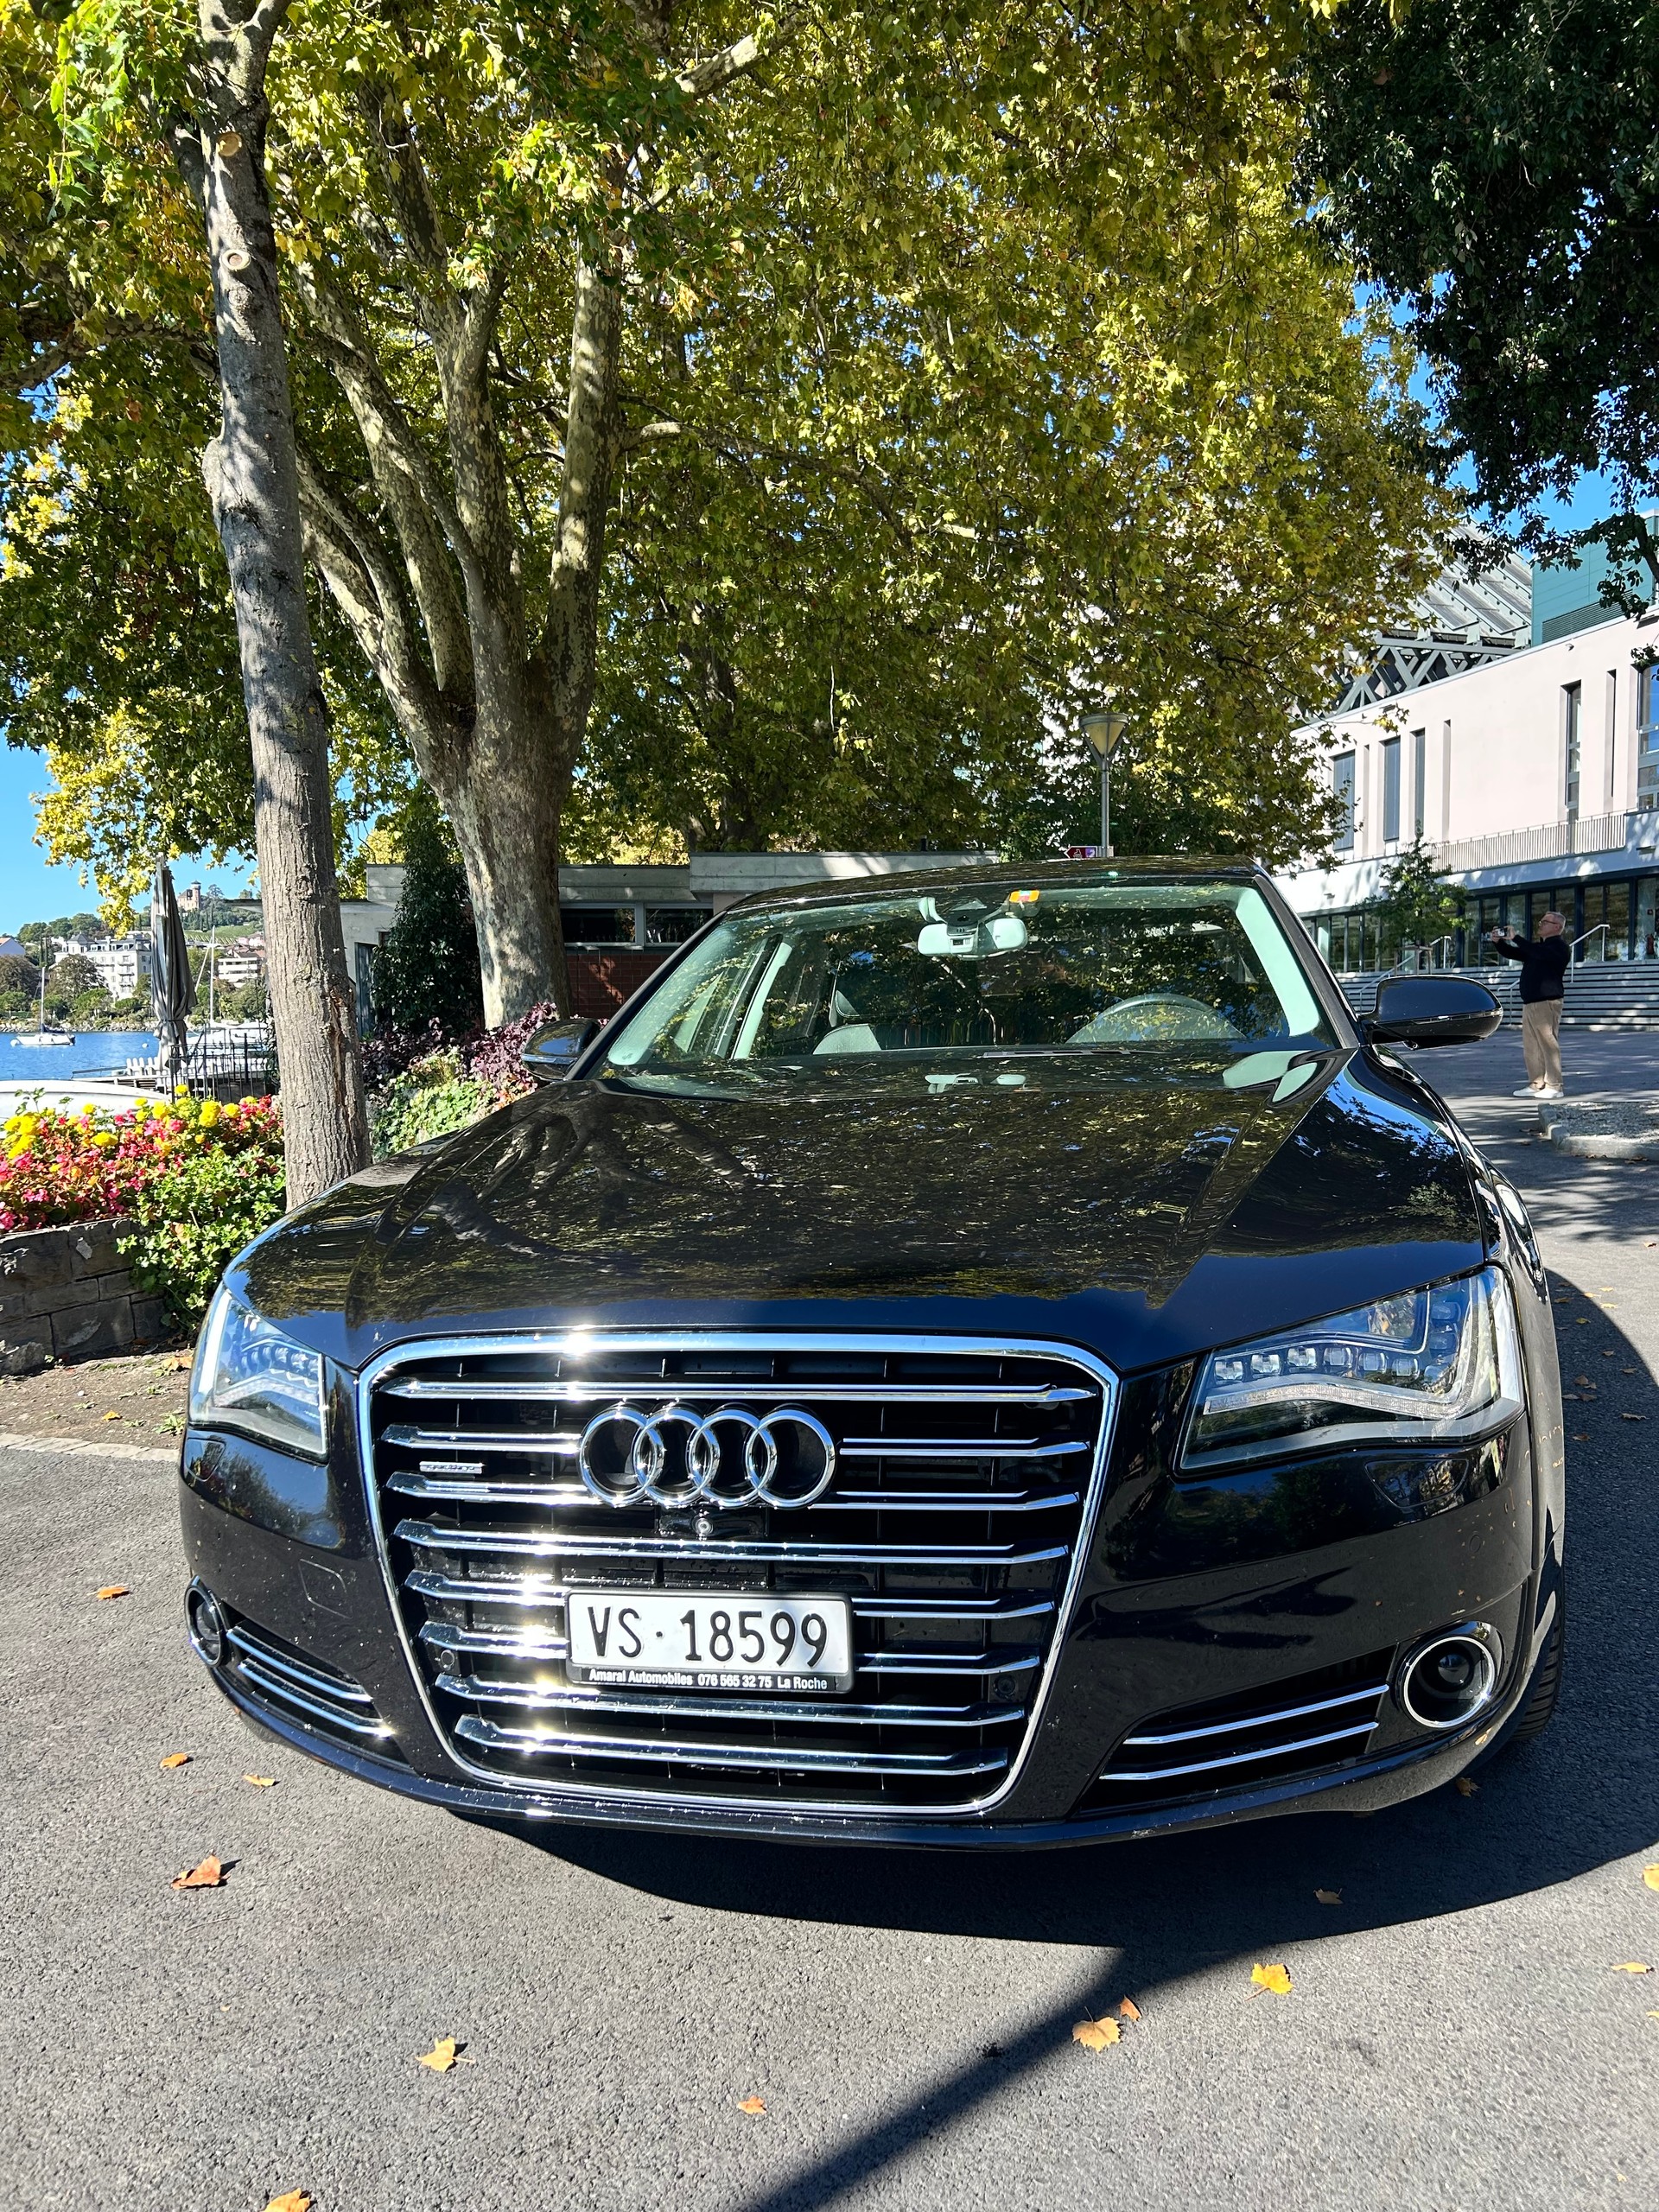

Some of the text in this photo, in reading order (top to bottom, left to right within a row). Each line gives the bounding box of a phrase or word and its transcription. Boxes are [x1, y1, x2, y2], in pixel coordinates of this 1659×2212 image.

[679, 1609, 829, 1669] 18599
[588, 1668, 626, 1682] Amaral
[627, 1669, 694, 1686] Automobiles
[697, 1673, 718, 1687] 076
[741, 1675, 757, 1688] 32
[758, 1675, 772, 1688] 75
[777, 1676, 792, 1689] La
[793, 1676, 828, 1690] Roche
